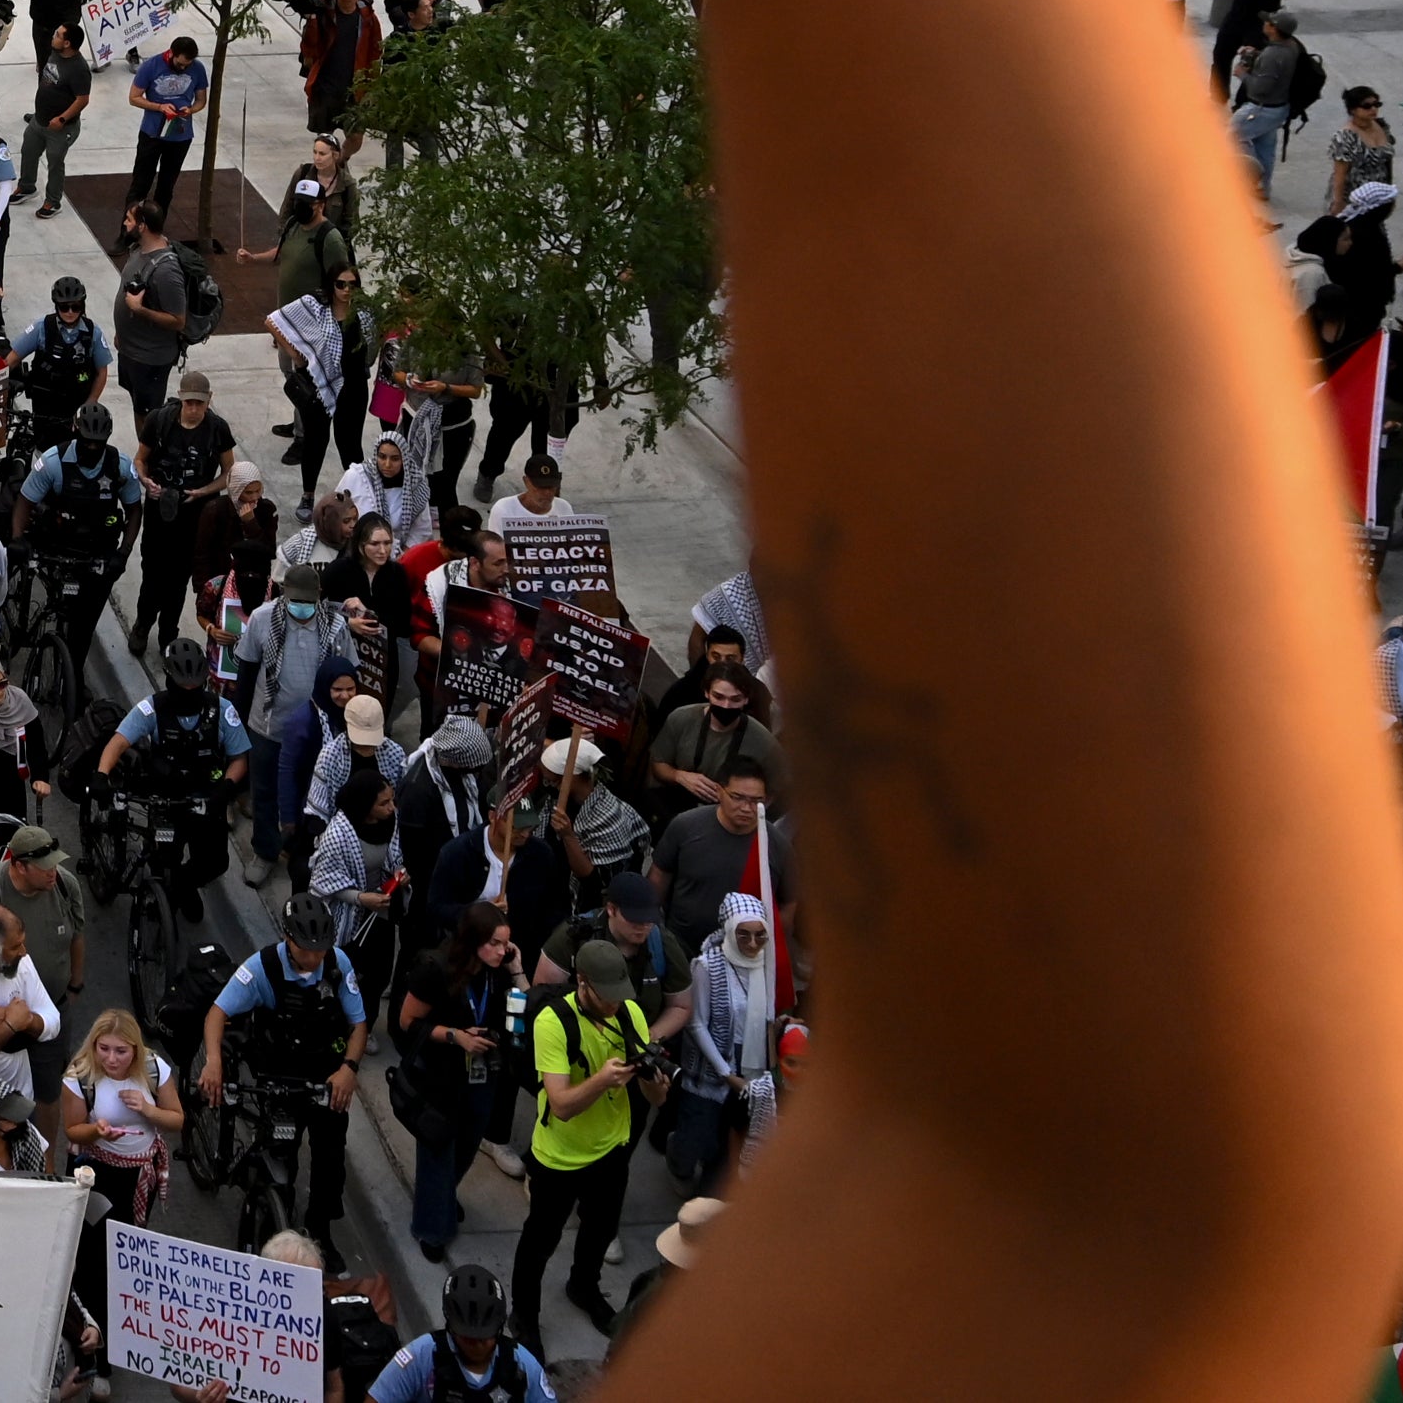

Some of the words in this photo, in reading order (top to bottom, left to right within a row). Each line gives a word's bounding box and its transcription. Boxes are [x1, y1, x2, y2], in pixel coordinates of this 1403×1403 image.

[511, 535, 567, 543] GENOCIDE
[569, 534, 602, 542] JOE'S
[513, 546, 605, 560] LEGACY:
[514, 566, 541, 575] THE
[544, 565, 607, 574] BUTCHER
[516, 580, 544, 592] OF
[550, 579, 610, 592] GAZA
[115, 1231, 160, 1259] SOME
[168, 1245, 251, 1281] ISRAELIS
[259, 1269, 295, 1288] ARE
[117, 1253, 181, 1285] DRUNK
[185, 1275, 202, 1288] ON
[202, 1279, 225, 1295] THE
[229, 1282, 292, 1310] BLOOD
[119, 1294, 152, 1316] THE
[161, 1305, 192, 1331] U.S.
[198, 1316, 267, 1350] MUST
[276, 1336, 319, 1363] END
[134, 1278, 154, 1296] OF
[159, 1284, 322, 1344] PALESTINIANS!
[121, 1316, 159, 1342] ALL
[162, 1329, 251, 1367] SUPPORT
[259, 1356, 281, 1375] TO
[127, 1350, 154, 1374] NO
